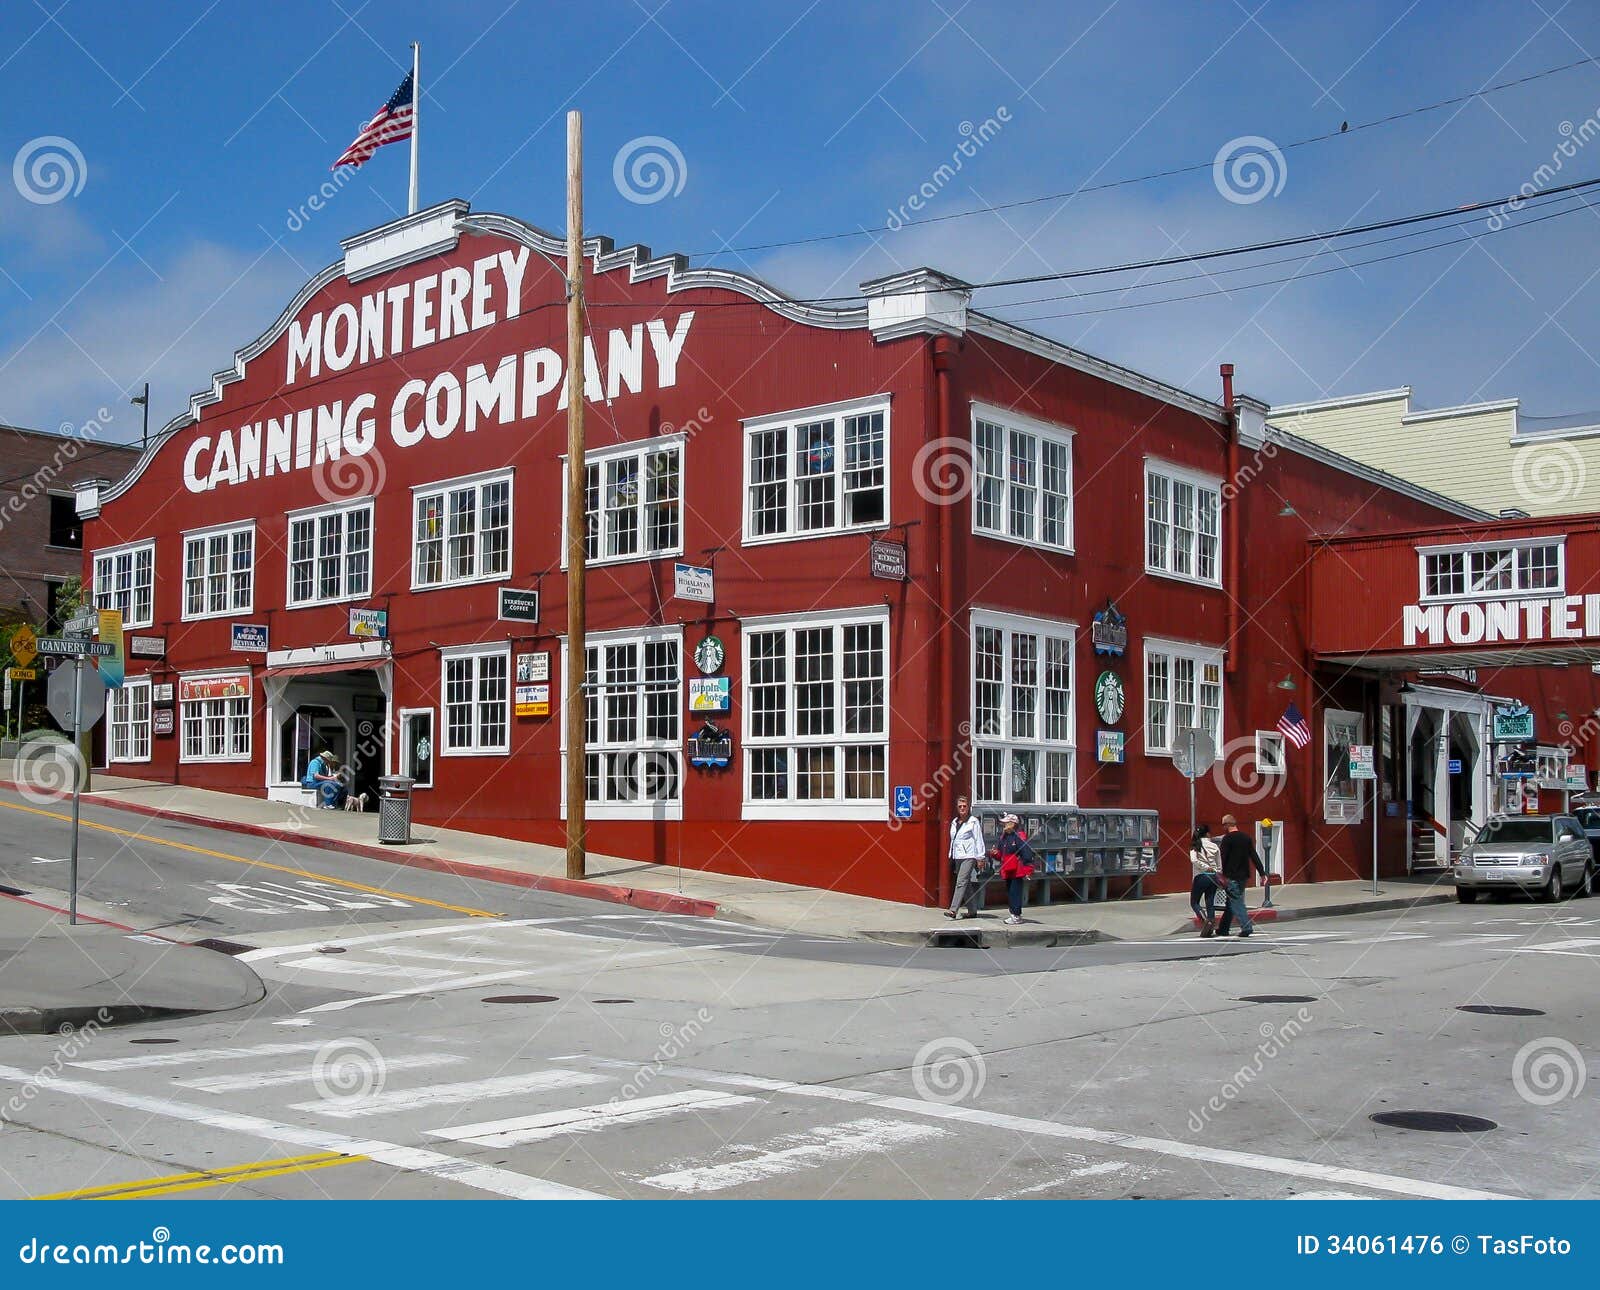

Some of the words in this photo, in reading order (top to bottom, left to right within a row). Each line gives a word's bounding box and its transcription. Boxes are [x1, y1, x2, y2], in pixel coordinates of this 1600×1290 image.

[286, 246, 530, 385] MONTEREY
[184, 393, 377, 494] CANNING
[391, 311, 695, 448] COMPANY
[678, 578, 711, 588] HIMALAYAN
[686, 586, 703, 595] GIFTS
[504, 598, 535, 607] STARBUCKS
[509, 604, 529, 612] COFFEE
[236, 632, 264, 641] AMERICAN
[41, 640, 86, 653] CANNERY
[90, 644, 111, 655] ROW
[325, 651, 336, 660] 711
[13, 669, 33, 678] XING
